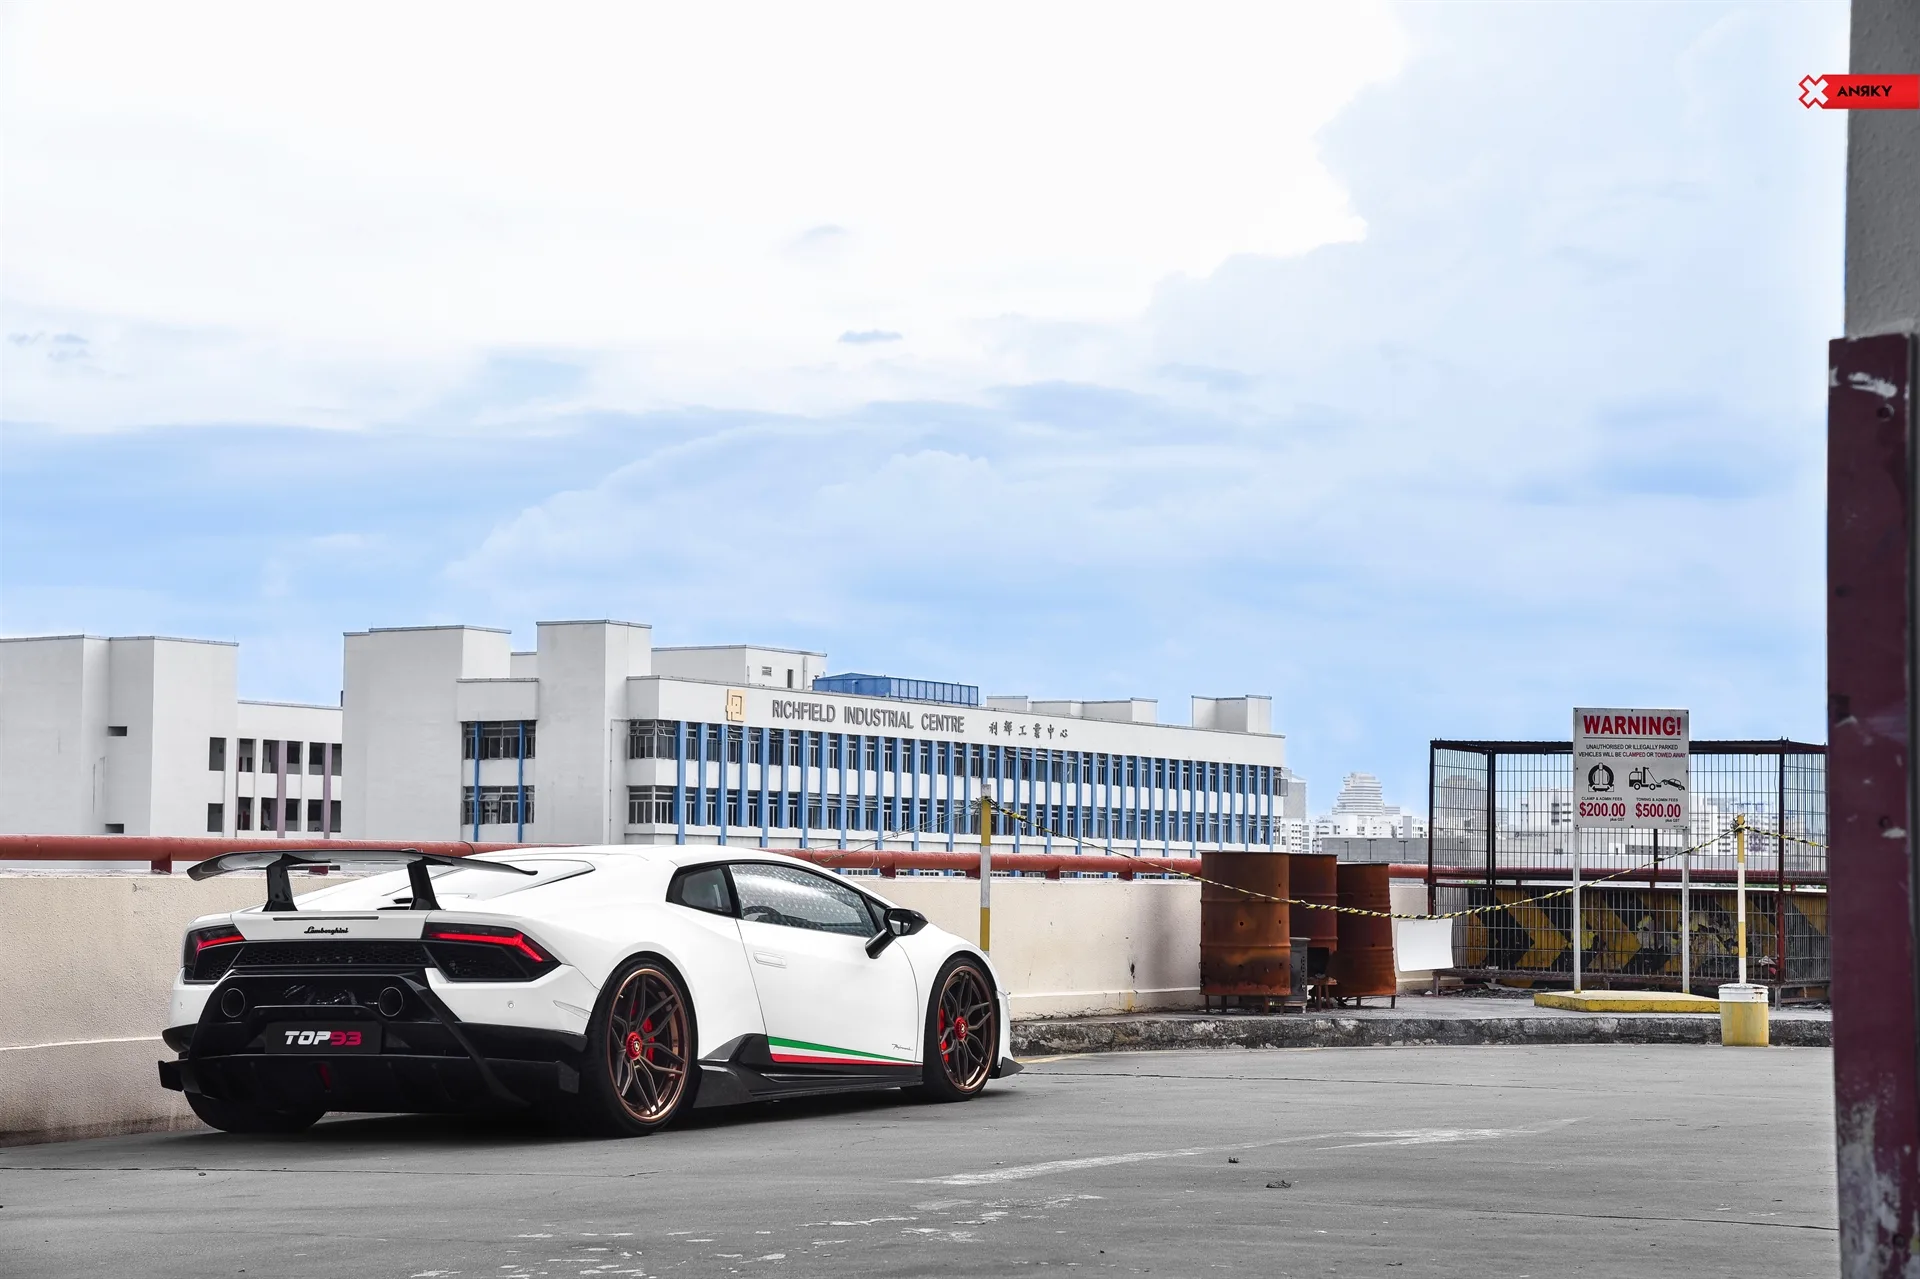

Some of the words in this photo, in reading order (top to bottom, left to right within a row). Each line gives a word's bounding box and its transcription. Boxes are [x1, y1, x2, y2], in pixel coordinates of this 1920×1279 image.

[772, 699, 836, 723] RICHFIELD
[844, 706, 914, 729] INDUSTRIAL
[921, 713, 965, 733] CENTRE
[1583, 715, 1681, 736] WARNING!
[1579, 802, 1626, 818] $200.00
[1635, 802, 1681, 818] $500.00
[284, 1030, 362, 1046] TOP93
